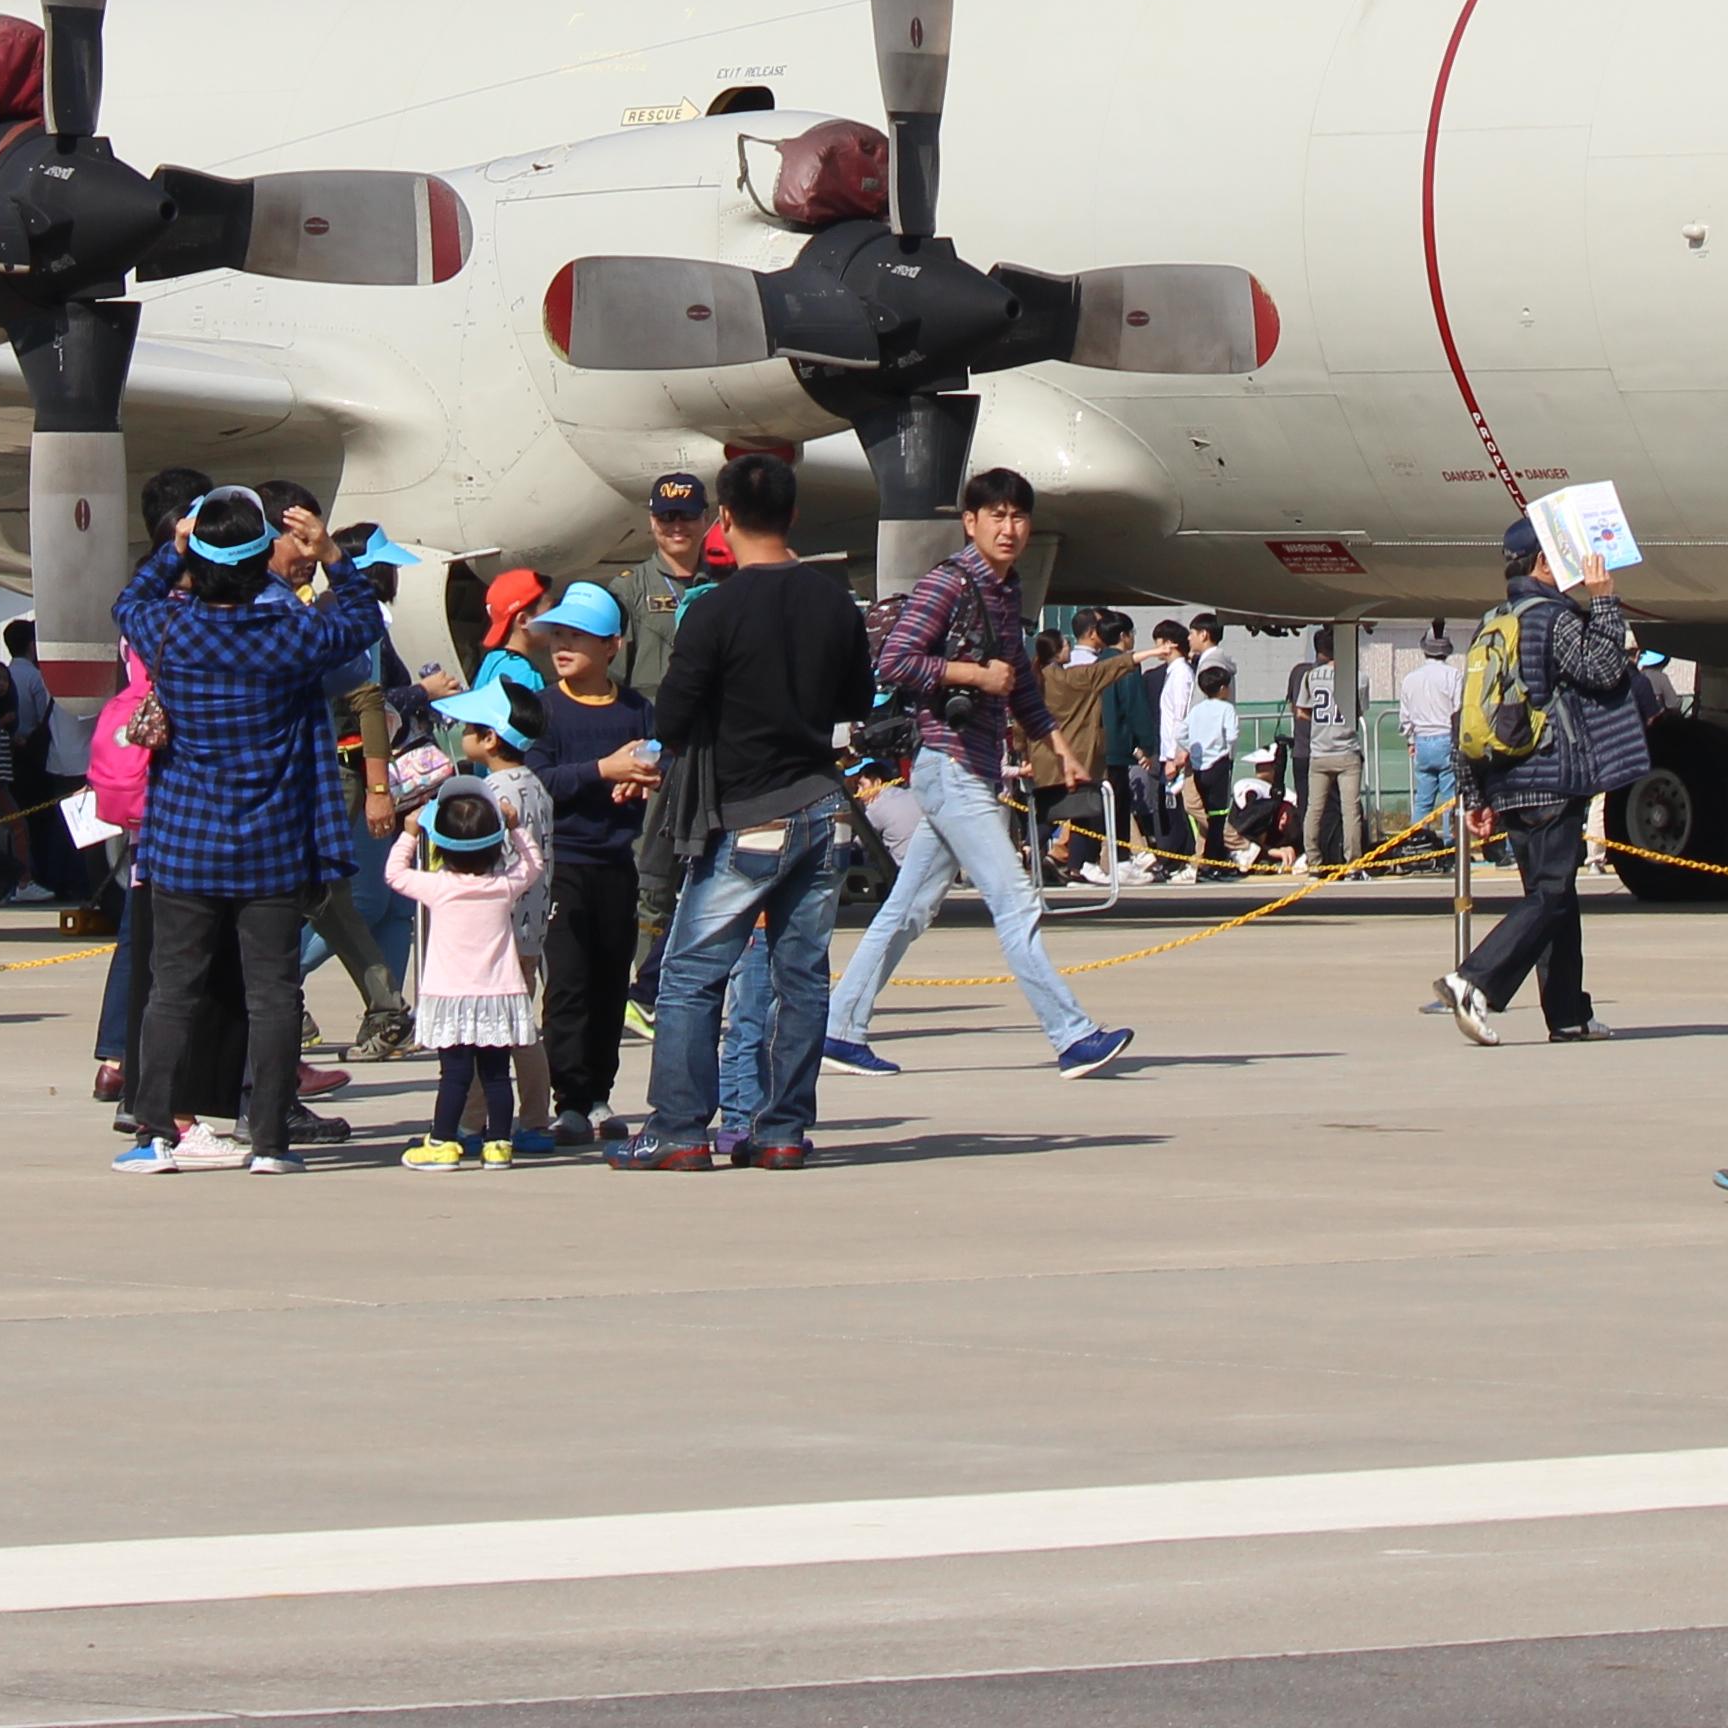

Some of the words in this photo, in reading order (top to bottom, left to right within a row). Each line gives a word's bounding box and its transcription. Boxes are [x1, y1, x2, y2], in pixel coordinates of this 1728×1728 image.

[716, 67, 742, 79] EXIT
[744, 65, 787, 77] RELEASE
[628, 109, 682, 122] RESCUE
[1472, 412, 1528, 509] PROPELL
[1441, 470, 1488, 482] DANGER
[1523, 468, 1570, 481] DANGER
